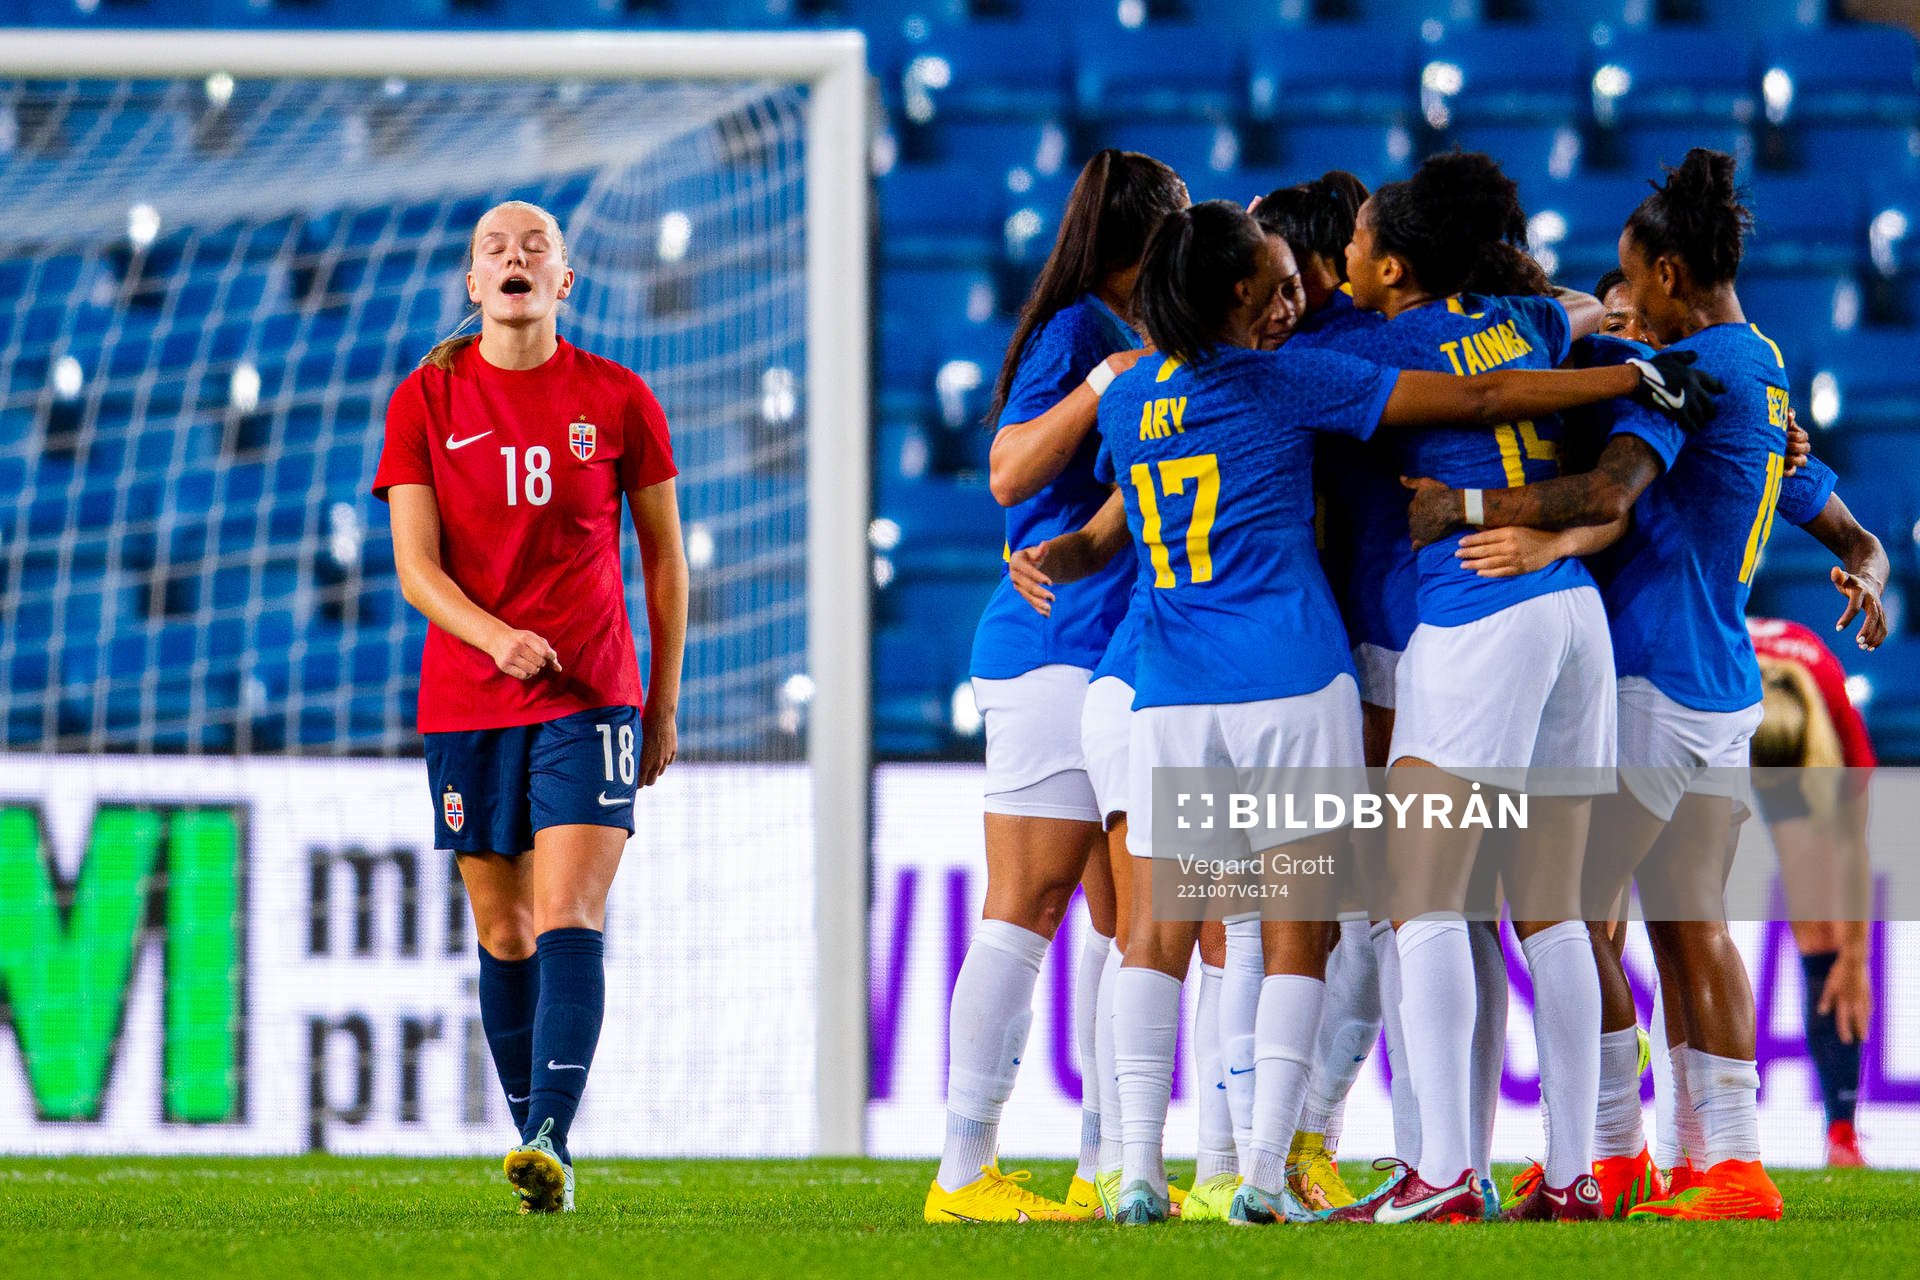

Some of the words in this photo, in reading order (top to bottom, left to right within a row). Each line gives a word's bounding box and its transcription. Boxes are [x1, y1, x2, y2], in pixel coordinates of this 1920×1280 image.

[1139, 396, 1188, 441] ARY
[500, 445, 552, 506] 18
[1130, 453, 1221, 589] 17
[595, 724, 635, 785] 18
